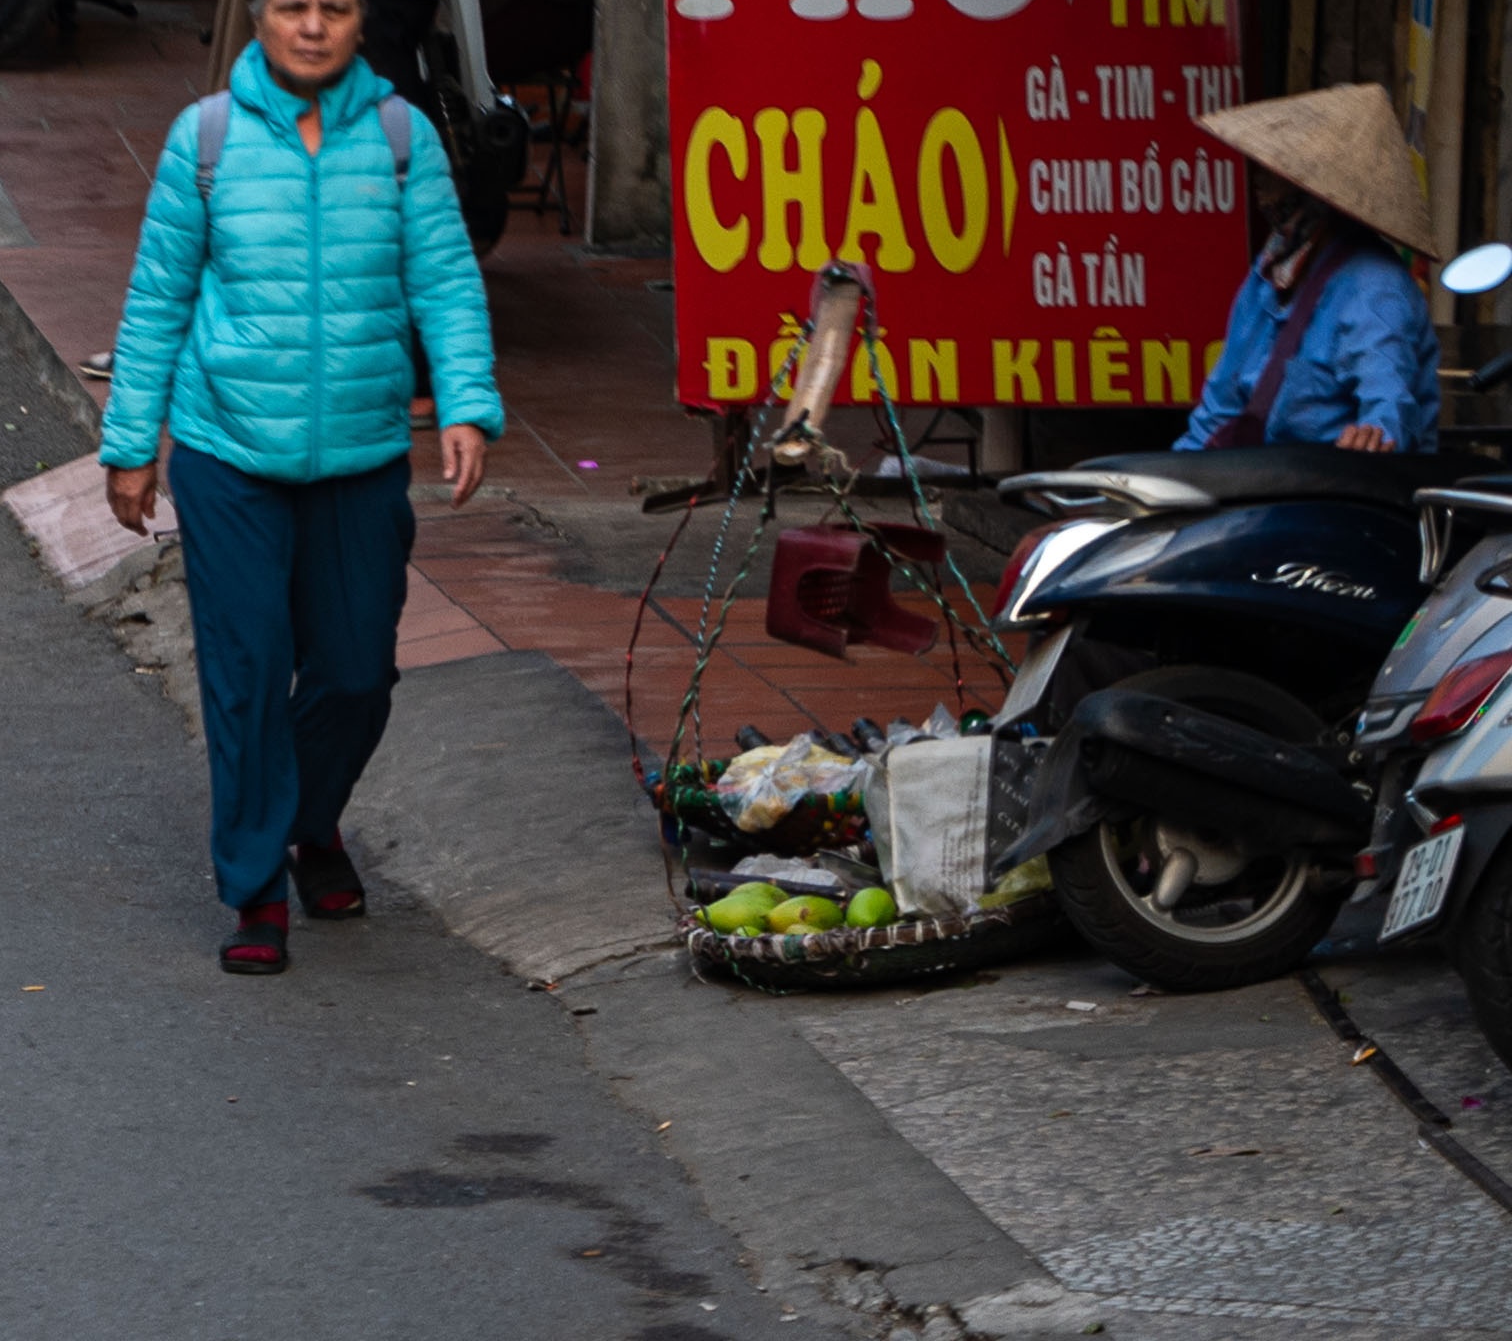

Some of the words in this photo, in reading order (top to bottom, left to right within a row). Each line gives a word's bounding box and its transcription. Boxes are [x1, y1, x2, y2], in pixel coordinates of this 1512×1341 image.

[683, 59, 990, 275] CHÁO
[1025, 55, 1070, 120] GÀ
[1096, 65, 1156, 120] TIM
[1029, 159, 1113, 214] CHIM
[1171, 147, 1235, 214] CÂU
[1033, 242, 1077, 308] GÀ
[1082, 234, 1146, 308] TẦN
